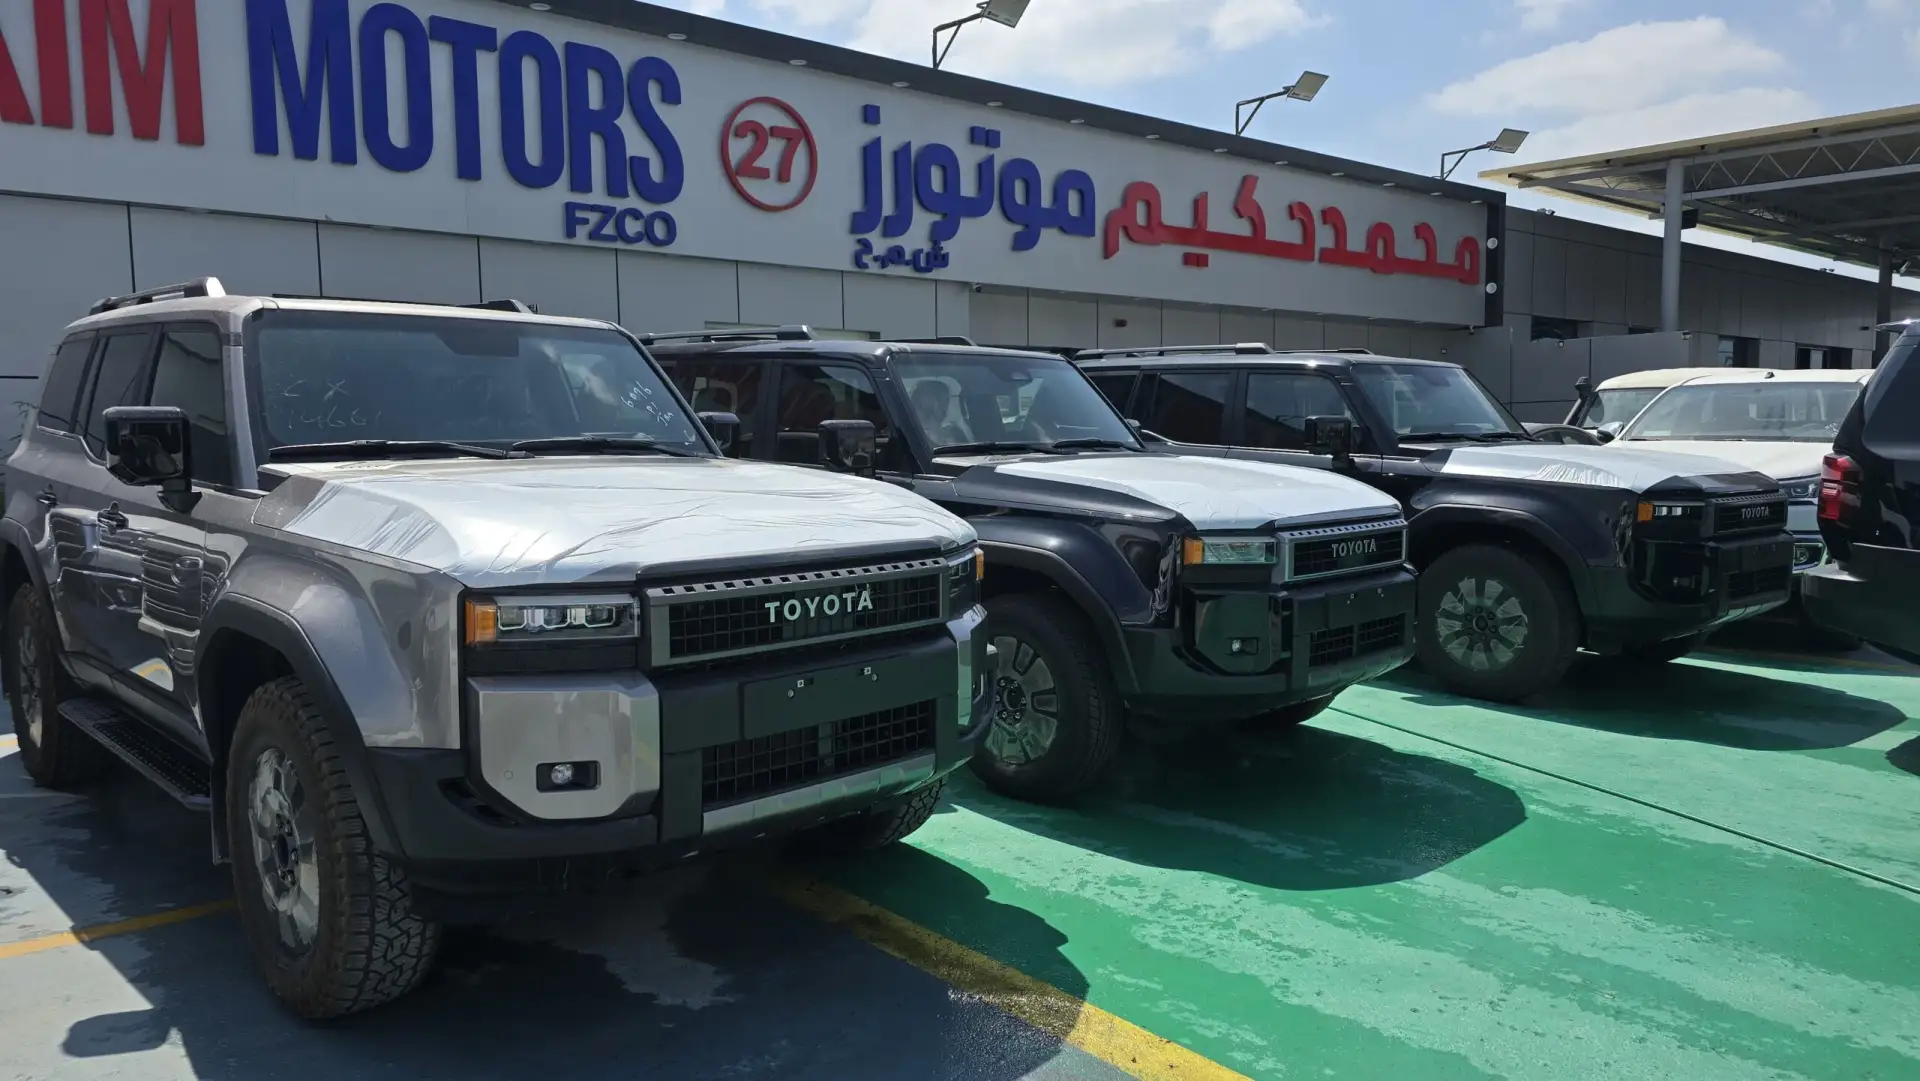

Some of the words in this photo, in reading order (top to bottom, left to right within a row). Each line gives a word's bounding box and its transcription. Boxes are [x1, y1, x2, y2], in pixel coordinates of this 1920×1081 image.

[246, 0, 684, 204] MOTORS
[735, 120, 804, 183] 27
[850, 103, 1096, 252] موتورز
[564, 201, 677, 247] FZCO
[1741, 506, 1769, 519] TOYOTA
[1332, 538, 1376, 557] TOYOTA
[764, 590, 873, 623] TOYOTA
